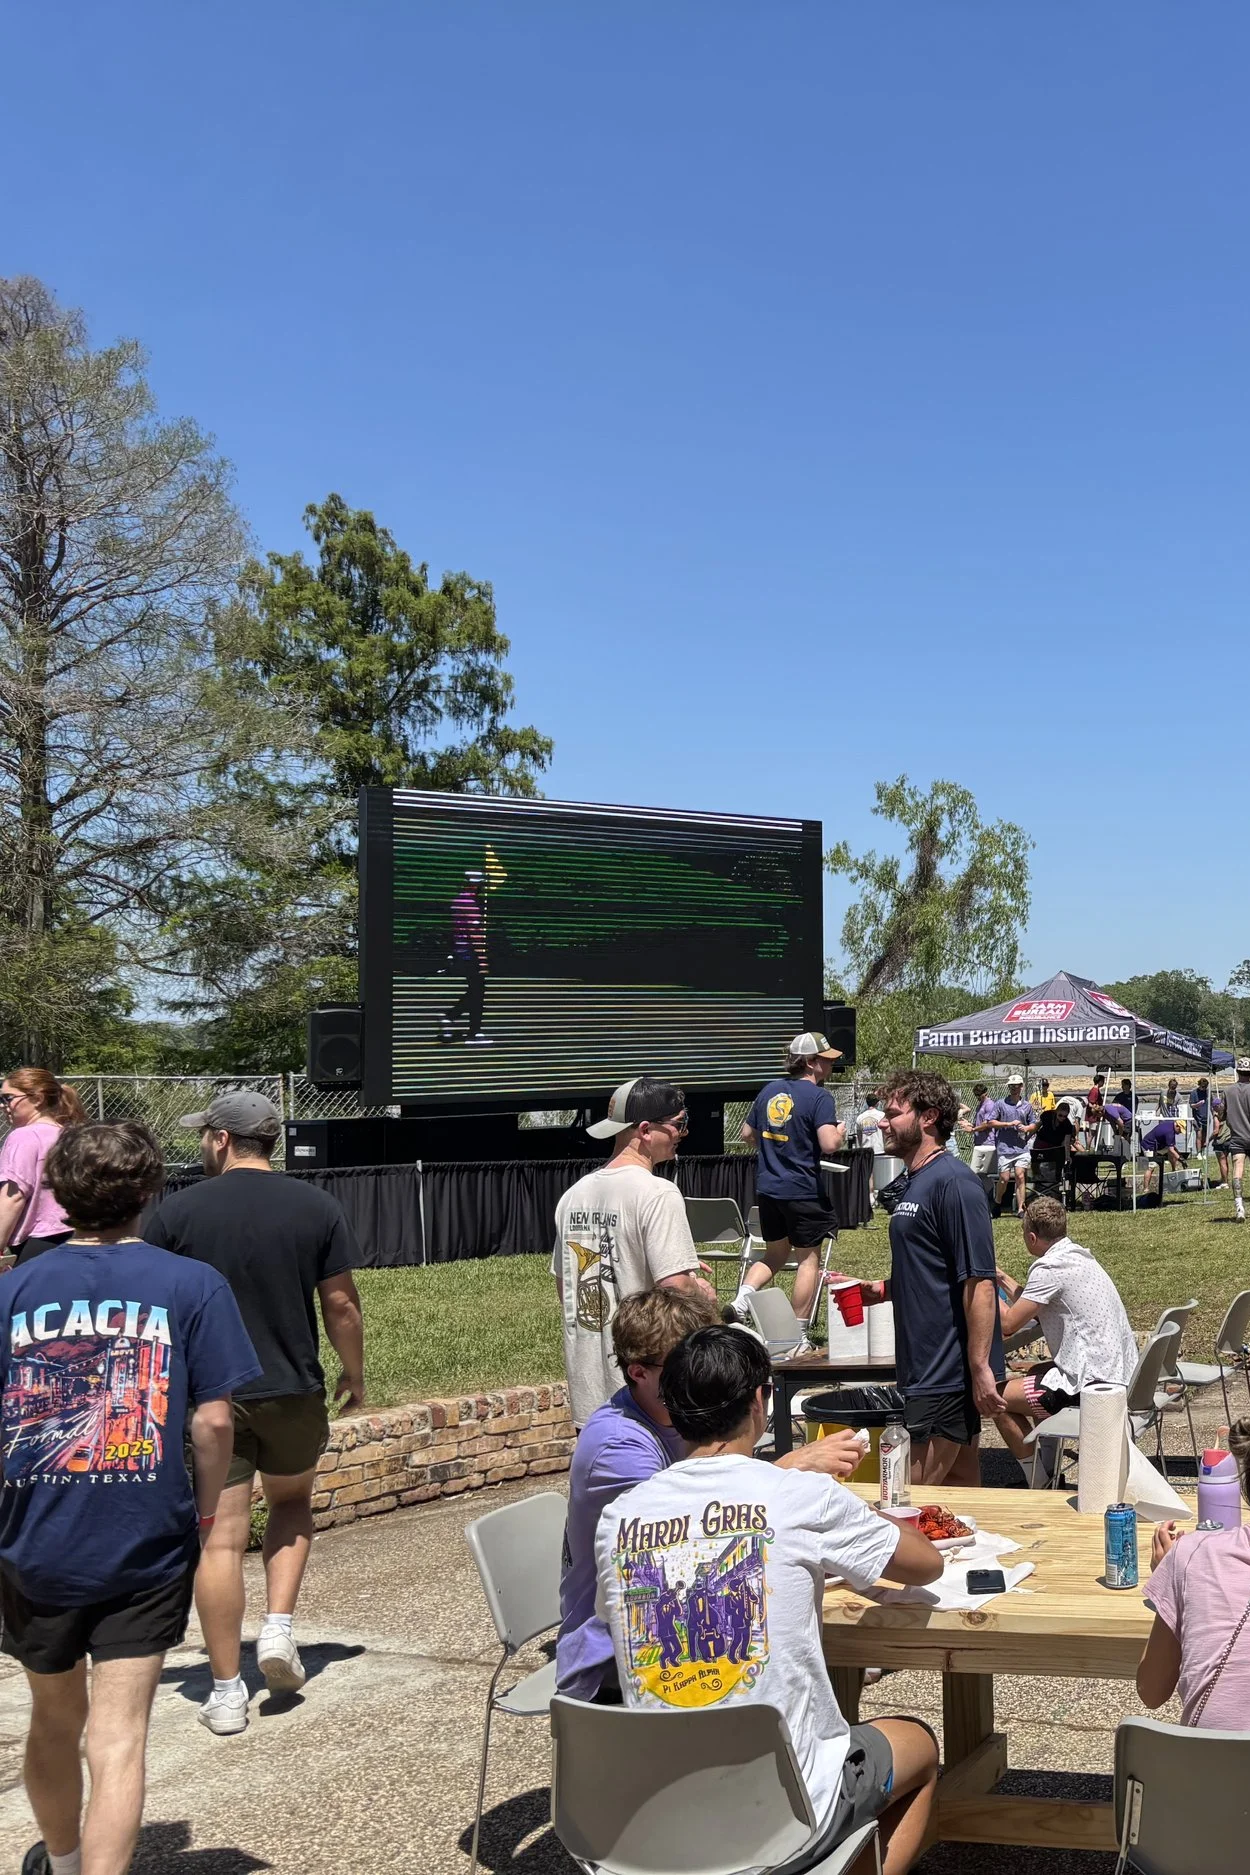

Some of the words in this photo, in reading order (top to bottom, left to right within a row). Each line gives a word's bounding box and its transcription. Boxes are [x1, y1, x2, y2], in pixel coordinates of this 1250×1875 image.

[1012, 1009, 1066, 1017] BUREAU
[918, 1029, 963, 1047] Farm
[969, 1028, 1034, 1046] Bureau
[1040, 1024, 1130, 1043] Insurance
[11, 1300, 172, 1353] ACACIA
[2, 1411, 99, 1458] Formal
[105, 1440, 155, 1461] 2025
[3, 1474, 80, 1488] AUSTIN,
[89, 1473, 158, 1484] TEXAS
[616, 1514, 691, 1554] MARDI
[700, 1500, 769, 1539] GRAS
